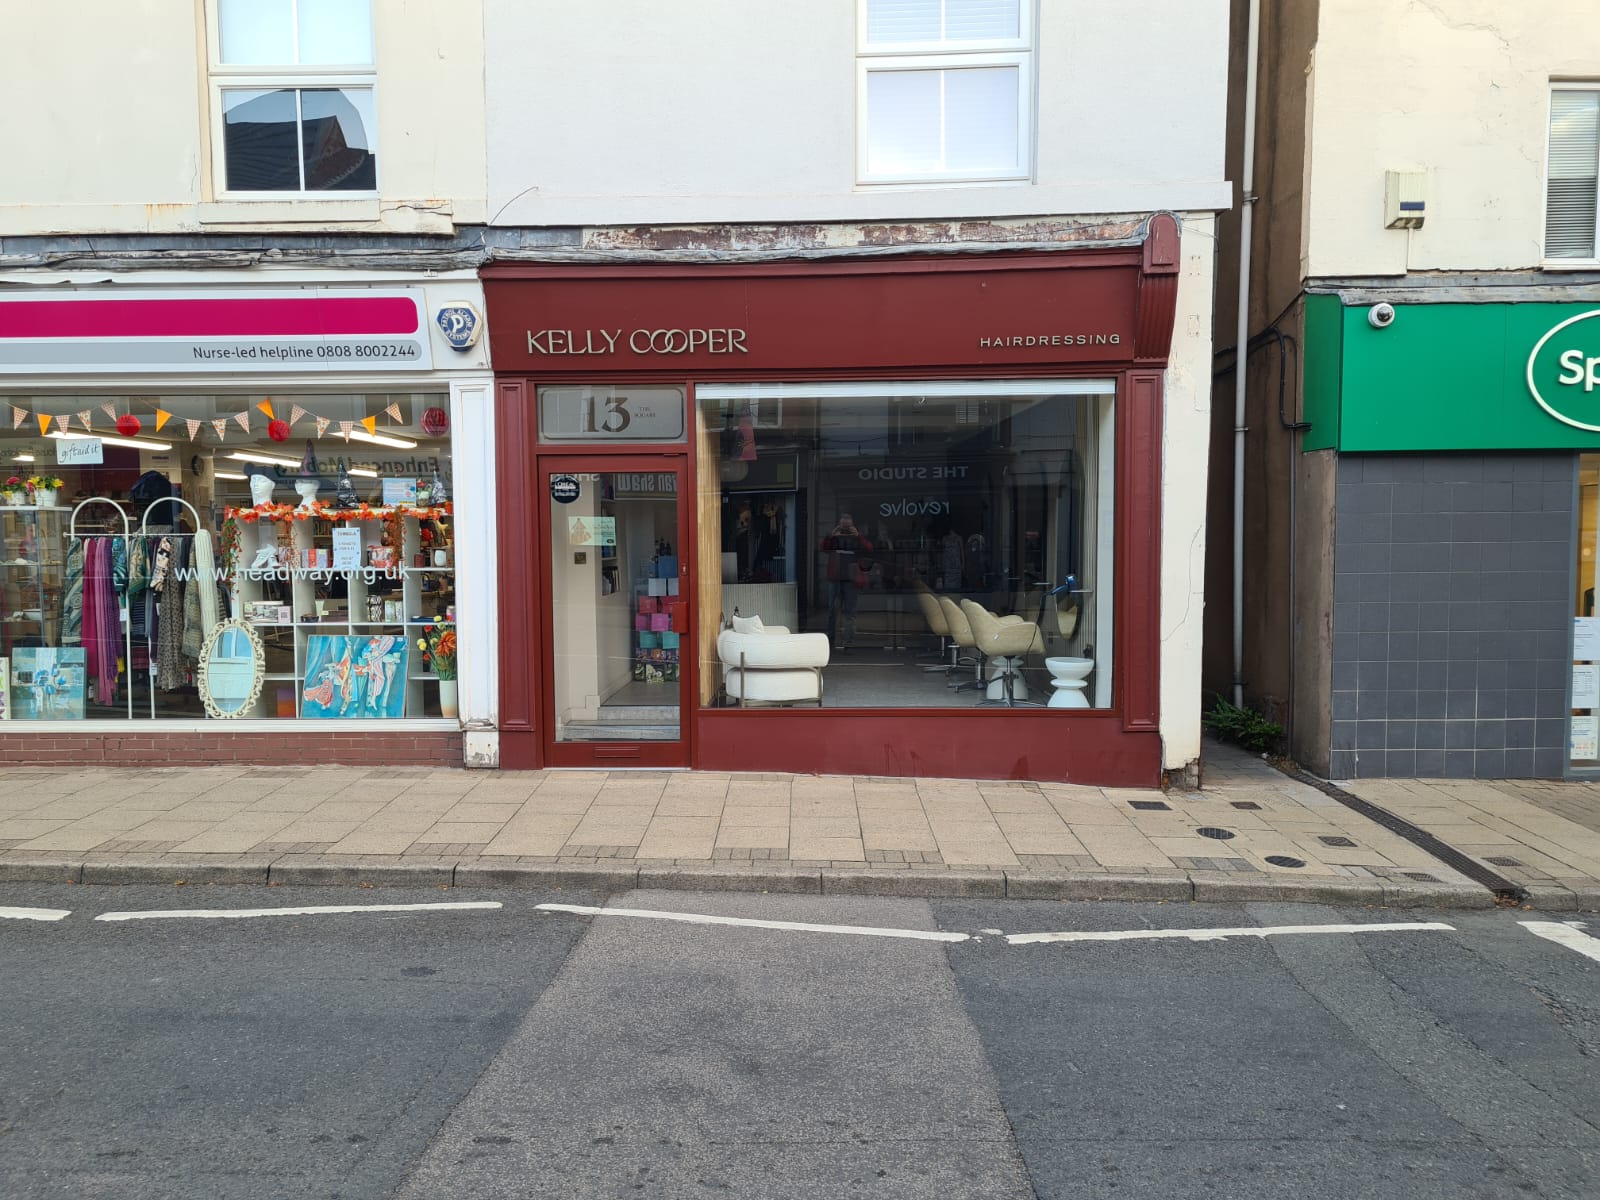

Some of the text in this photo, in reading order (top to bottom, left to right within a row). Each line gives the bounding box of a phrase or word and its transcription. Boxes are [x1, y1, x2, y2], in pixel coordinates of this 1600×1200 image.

[527, 329, 748, 354] KELLY COOPER
[980, 334, 1120, 348] HAIRDRESSING
[193, 344, 415, 361] Nurse-led helpline 0808 8002244
[583, 396, 631, 433] 13
